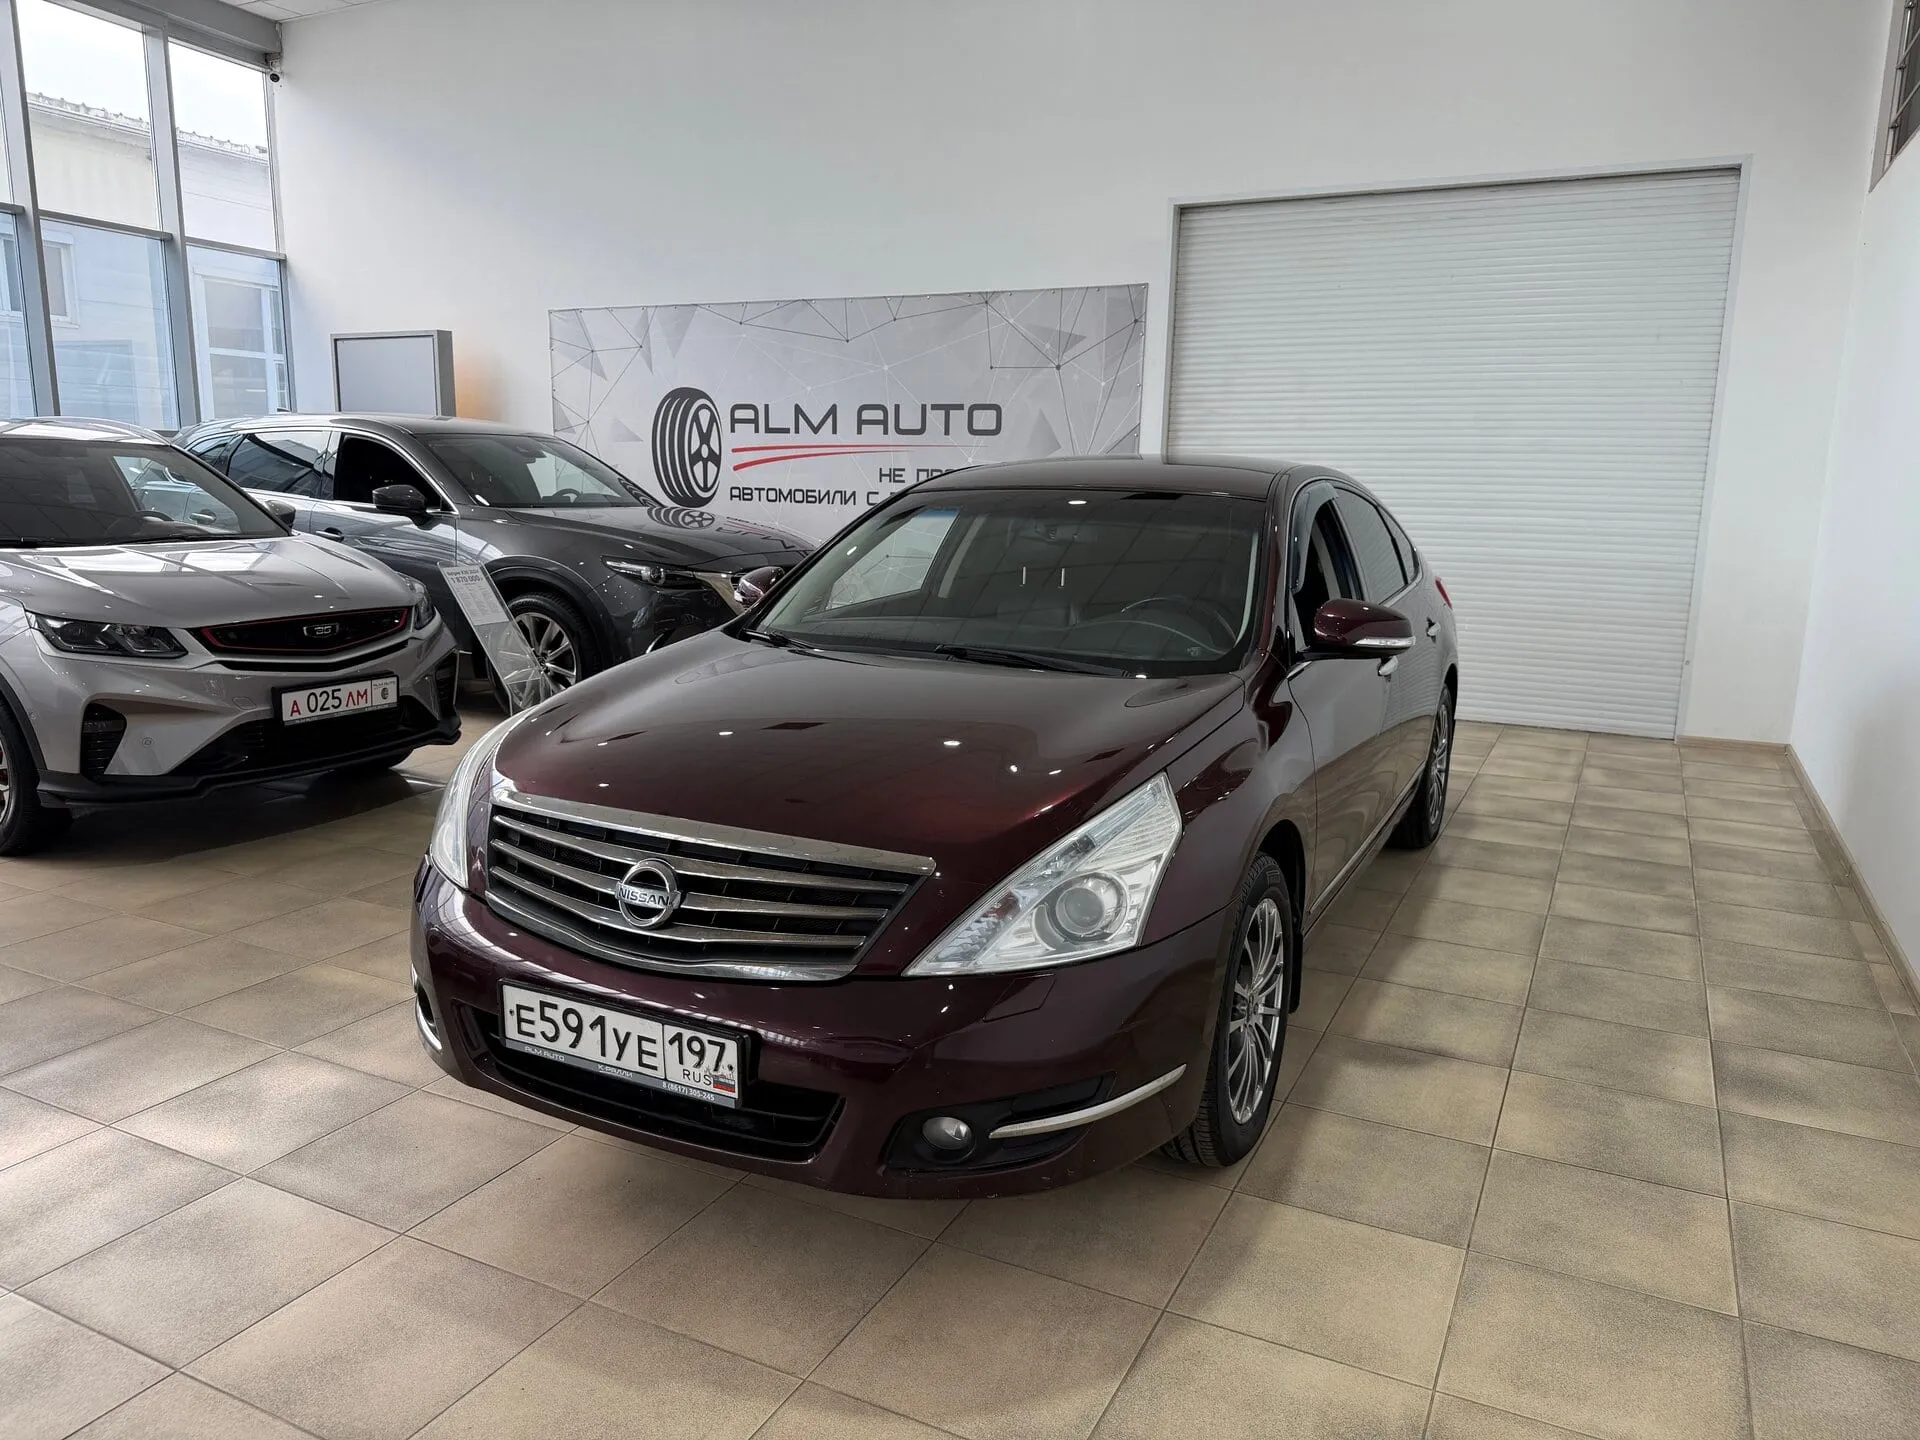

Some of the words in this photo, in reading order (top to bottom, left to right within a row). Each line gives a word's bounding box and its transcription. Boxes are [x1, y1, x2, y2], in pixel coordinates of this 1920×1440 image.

[729, 402, 838, 436] ALM
[855, 402, 1003, 437] AUTO
[878, 467, 906, 483] НЕ
[729, 486, 856, 505] АВТОМОБИЛИ
[307, 688, 342, 713] 025
[618, 887, 670, 906] NISSAN
[682, 1068, 712, 1086] RUS
